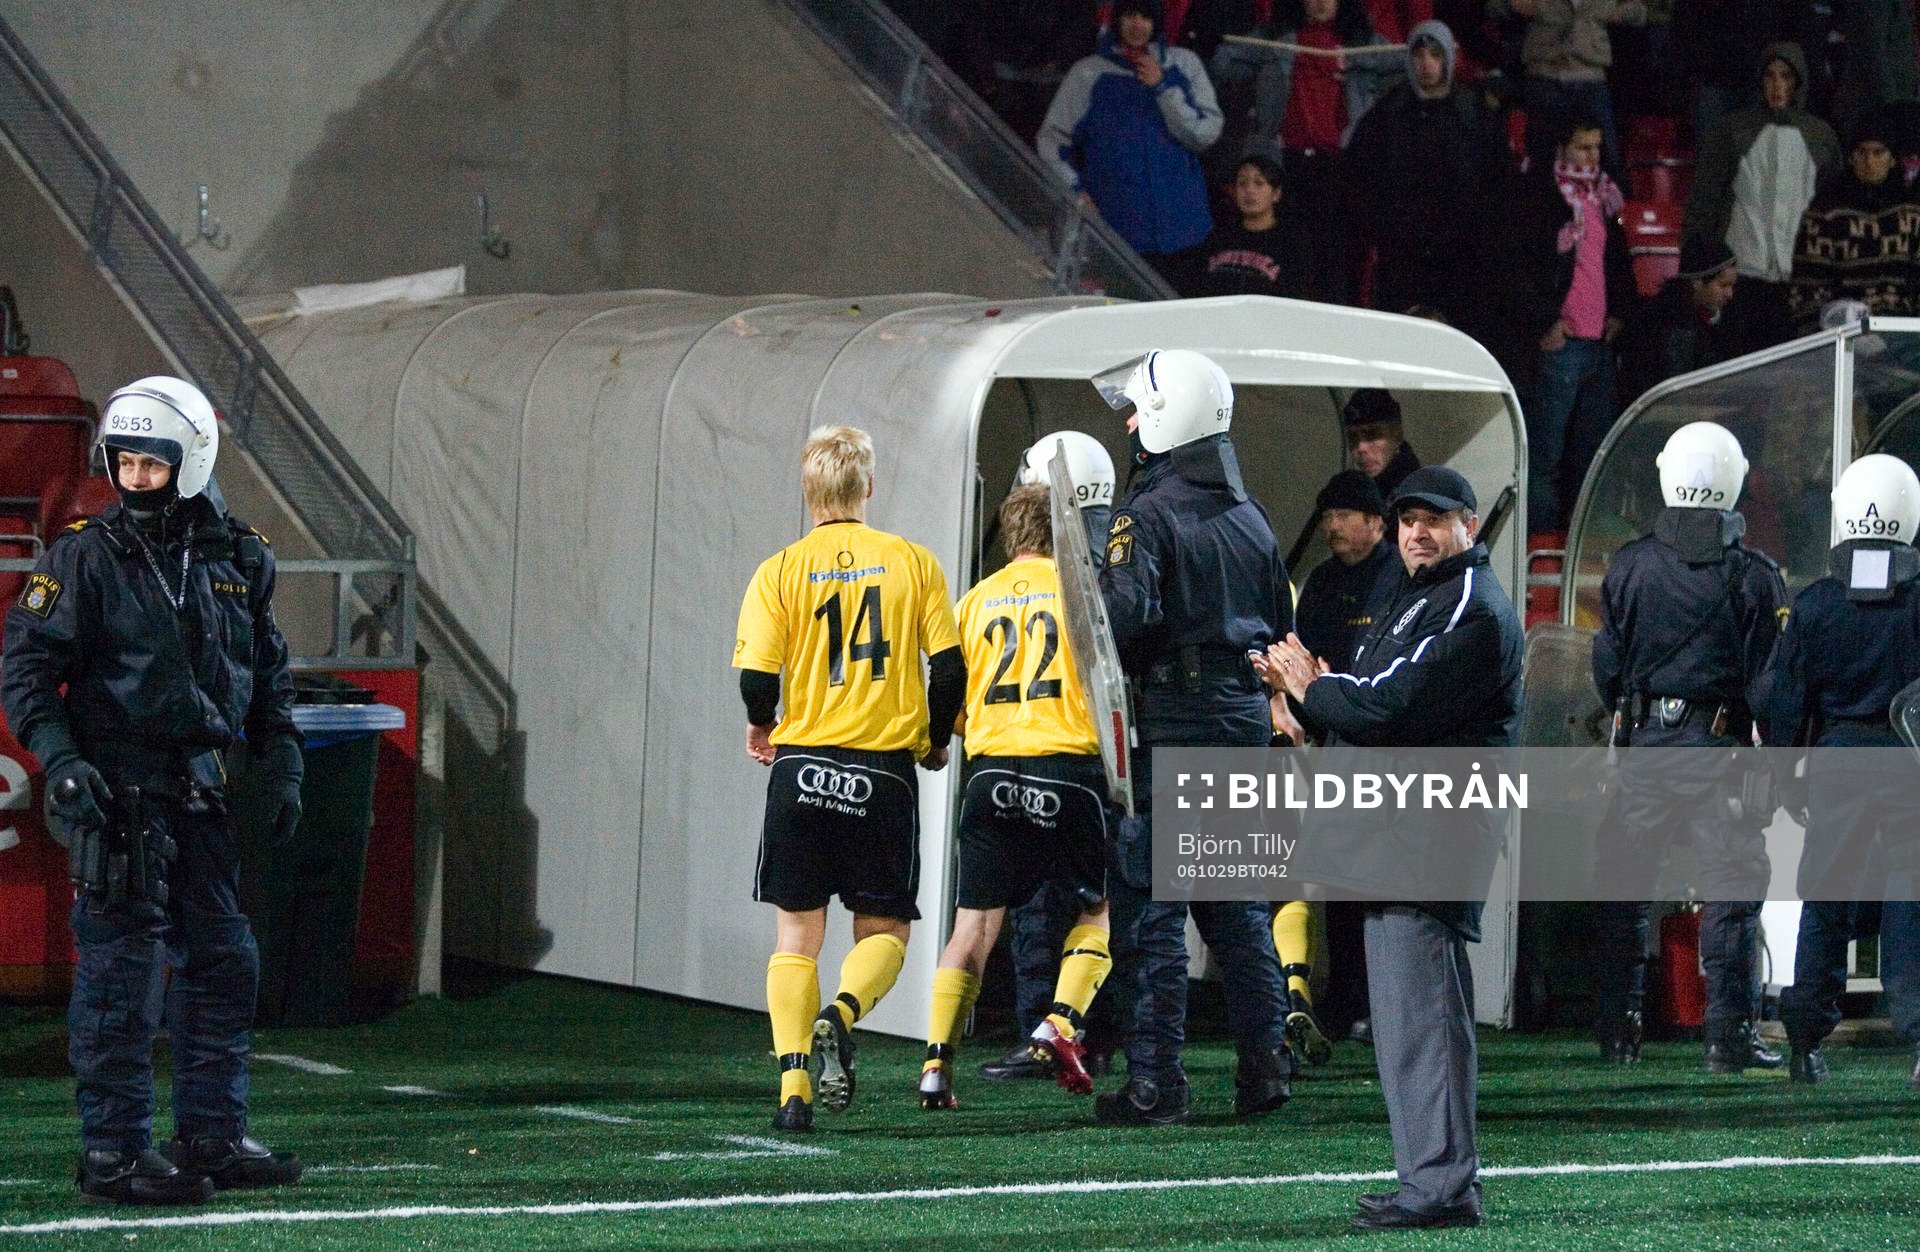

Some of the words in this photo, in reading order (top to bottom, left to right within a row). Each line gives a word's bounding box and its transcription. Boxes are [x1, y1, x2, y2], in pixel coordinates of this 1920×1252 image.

[112, 415, 153, 431] 9553
[1866, 503, 1879, 518] A
[1846, 519, 1900, 535] 3599
[33, 576, 58, 591] POLIS
[215, 582, 247, 593] POLIS
[814, 585, 891, 687] 14
[984, 611, 1062, 705] 22
[797, 793, 823, 807] Audi
[826, 800, 867, 817] Malmö
